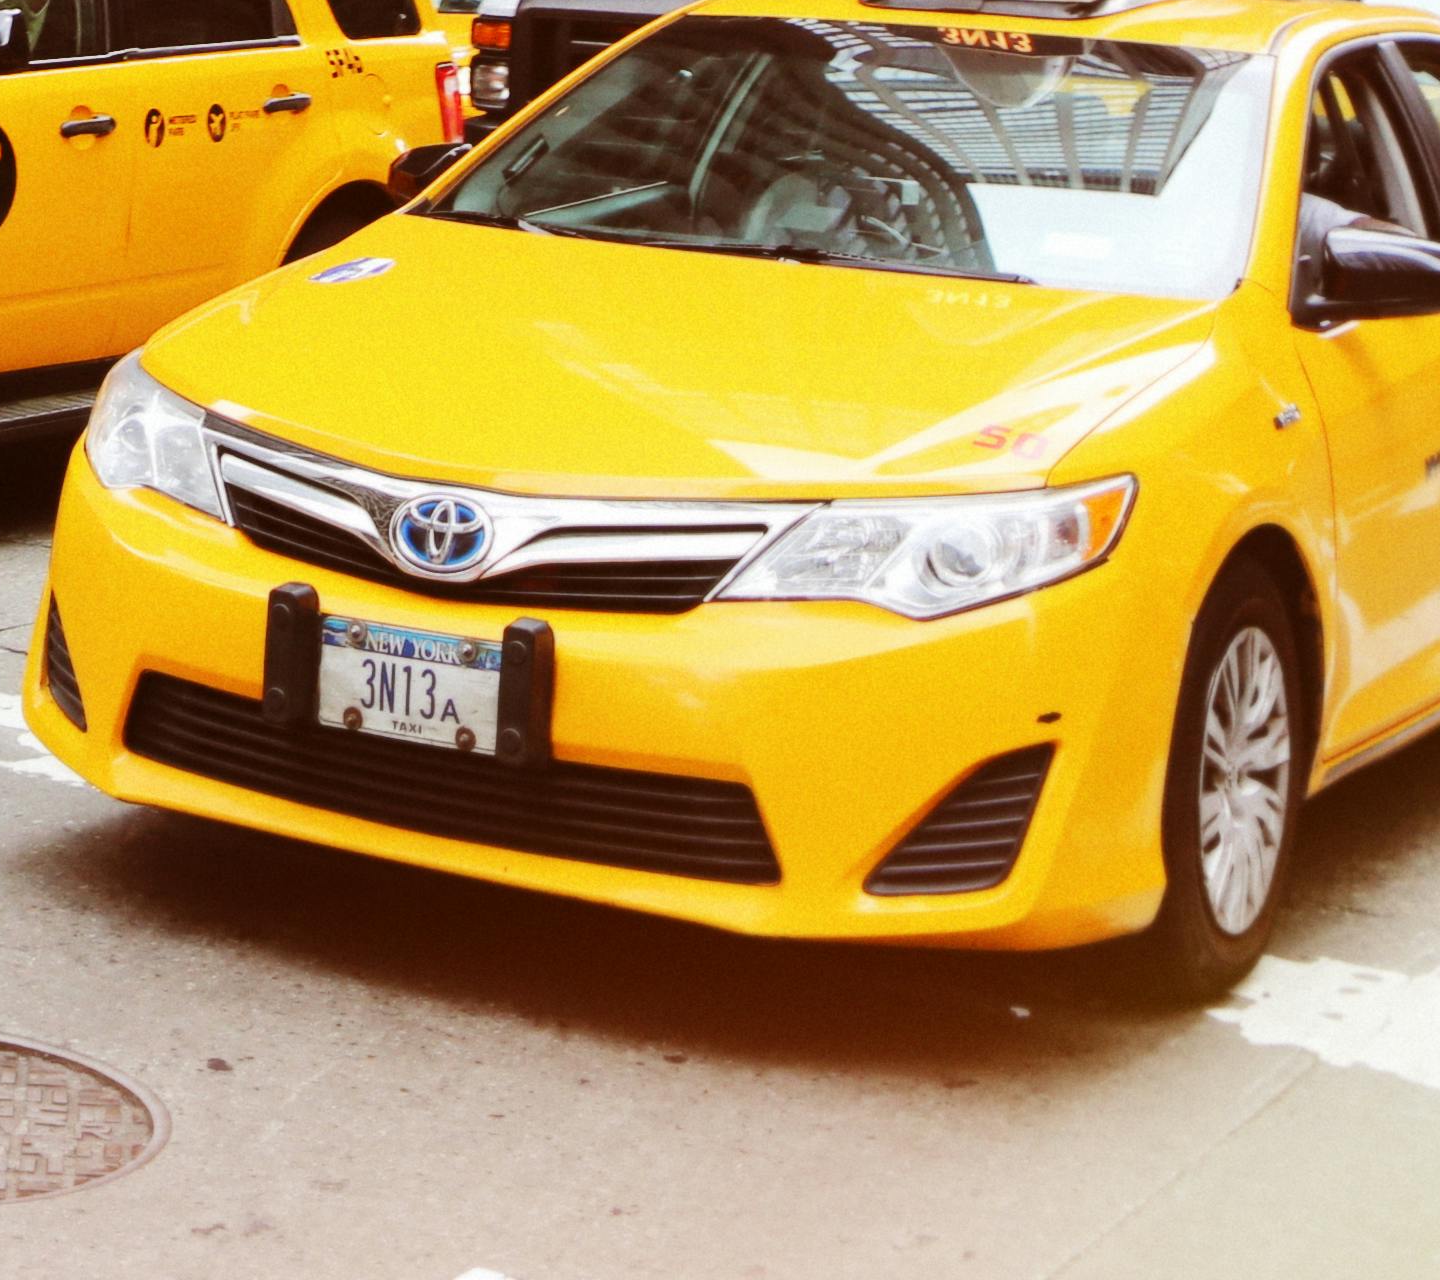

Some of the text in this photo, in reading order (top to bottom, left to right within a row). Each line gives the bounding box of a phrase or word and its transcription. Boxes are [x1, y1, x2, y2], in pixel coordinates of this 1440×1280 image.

[364, 631, 462, 666] NEW YORK
[391, 720, 423, 735] TAXI
